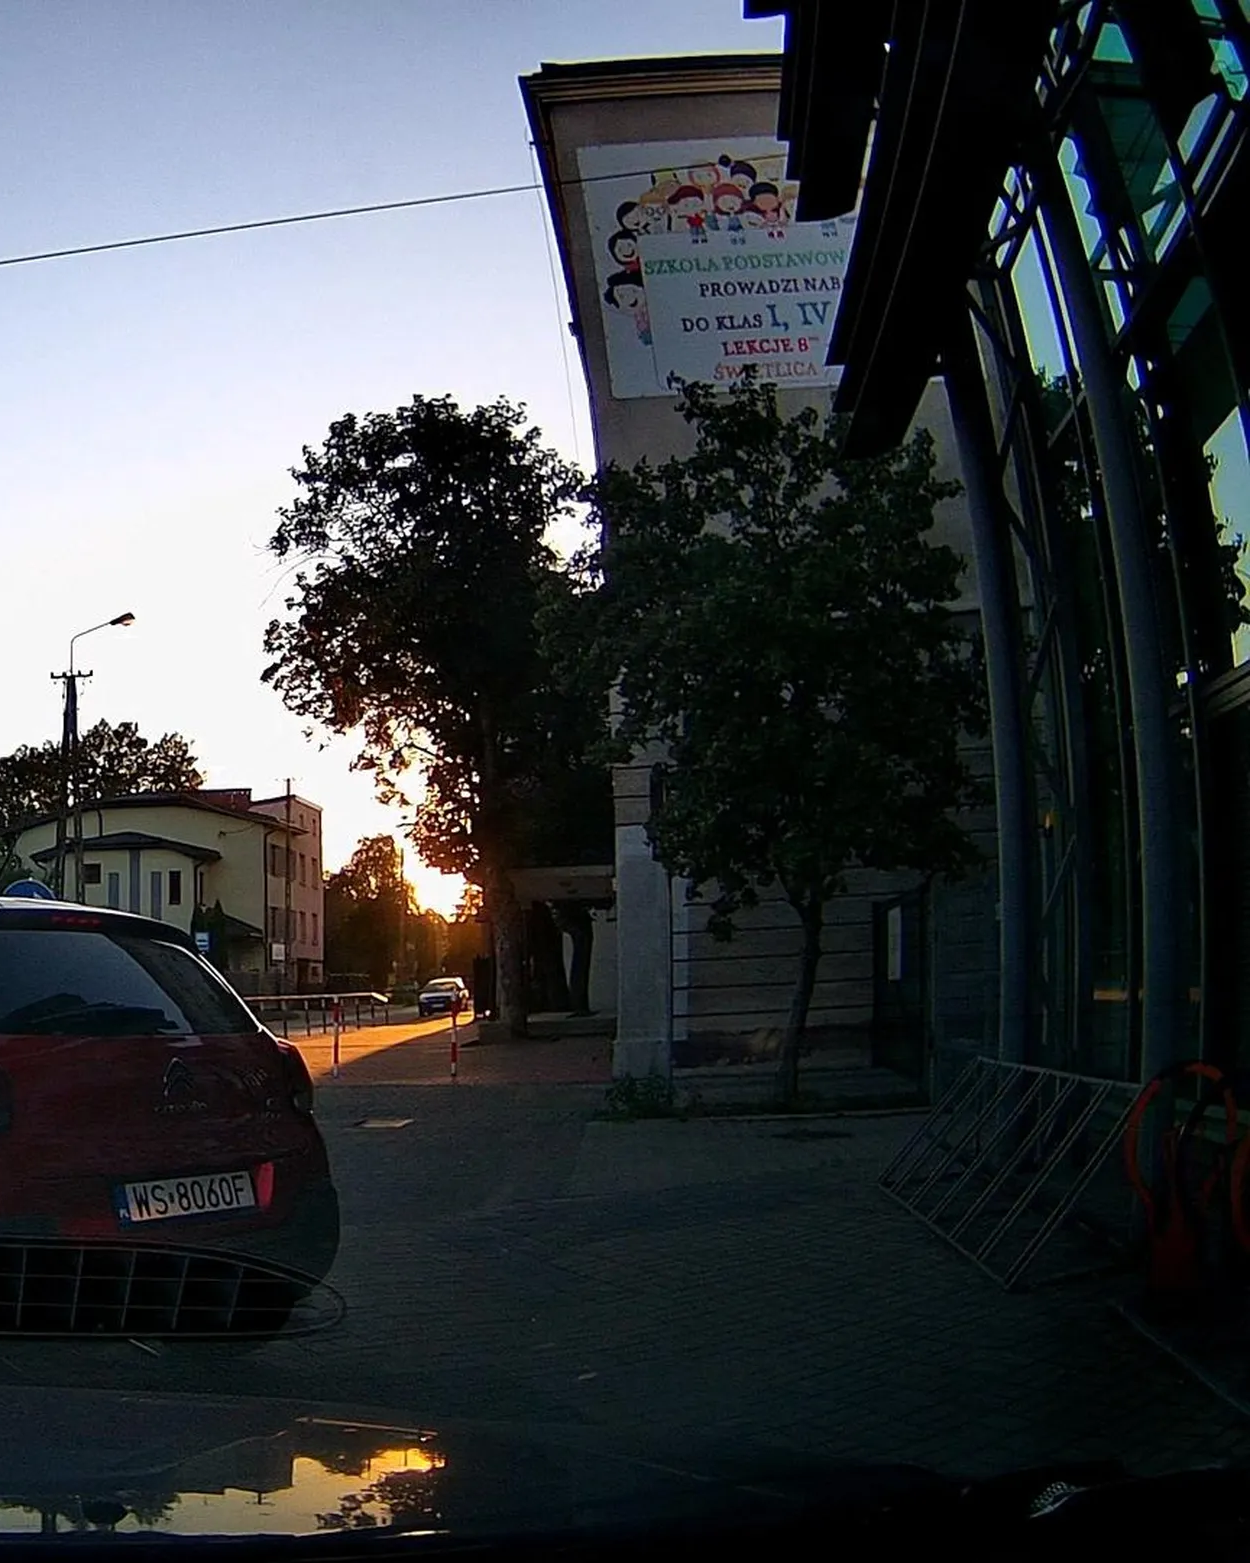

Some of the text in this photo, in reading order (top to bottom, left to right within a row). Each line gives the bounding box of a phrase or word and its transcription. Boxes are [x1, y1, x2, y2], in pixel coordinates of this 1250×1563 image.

[699, 278, 799, 298] PROWADZI
[681, 317, 709, 332] DO
[715, 313, 762, 330] KLAS
[796, 300, 831, 325] IV
[721, 338, 793, 356] LEKCJE
[176, 1174, 244, 1213] 8060F
